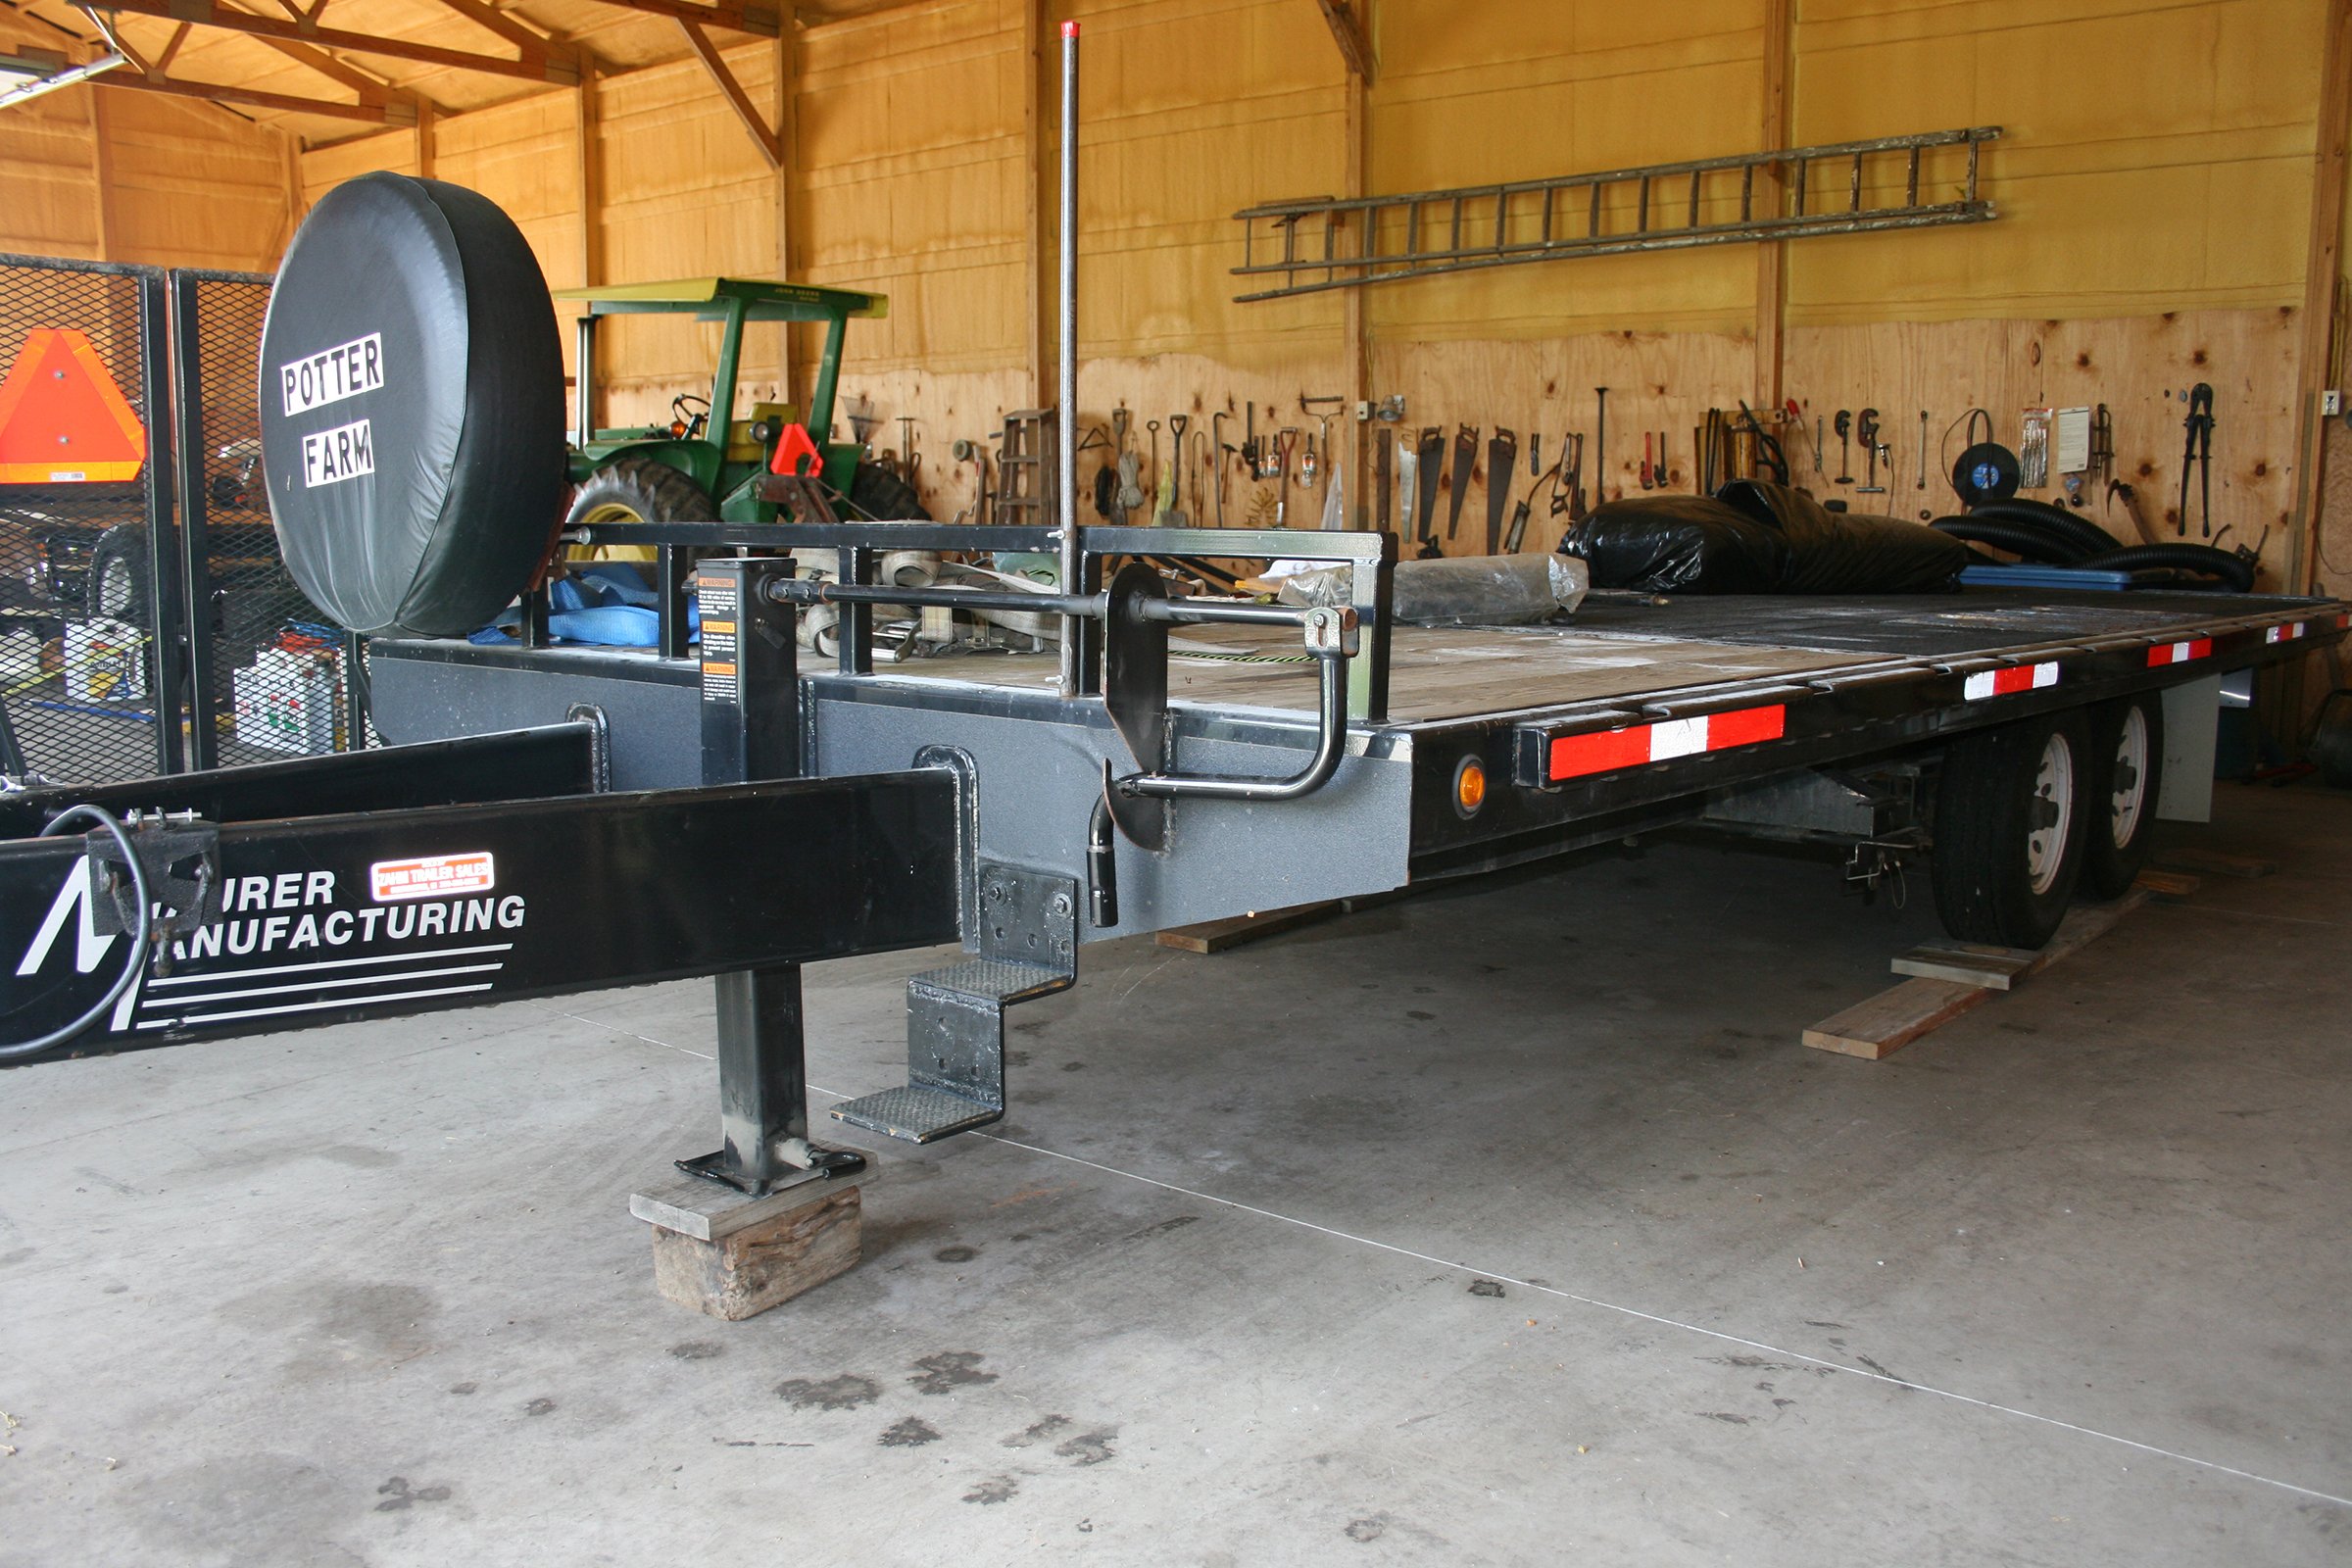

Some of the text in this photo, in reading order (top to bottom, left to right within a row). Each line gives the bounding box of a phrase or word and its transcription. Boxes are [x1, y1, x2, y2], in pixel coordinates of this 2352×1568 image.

[285, 339, 380, 412] POTTER
[305, 424, 372, 483] FARM
[710, 622, 734, 631] WARNING
[710, 664, 734, 673] WARNING
[410, 865, 455, 882] TRAILER
[455, 861, 488, 878] SALES
